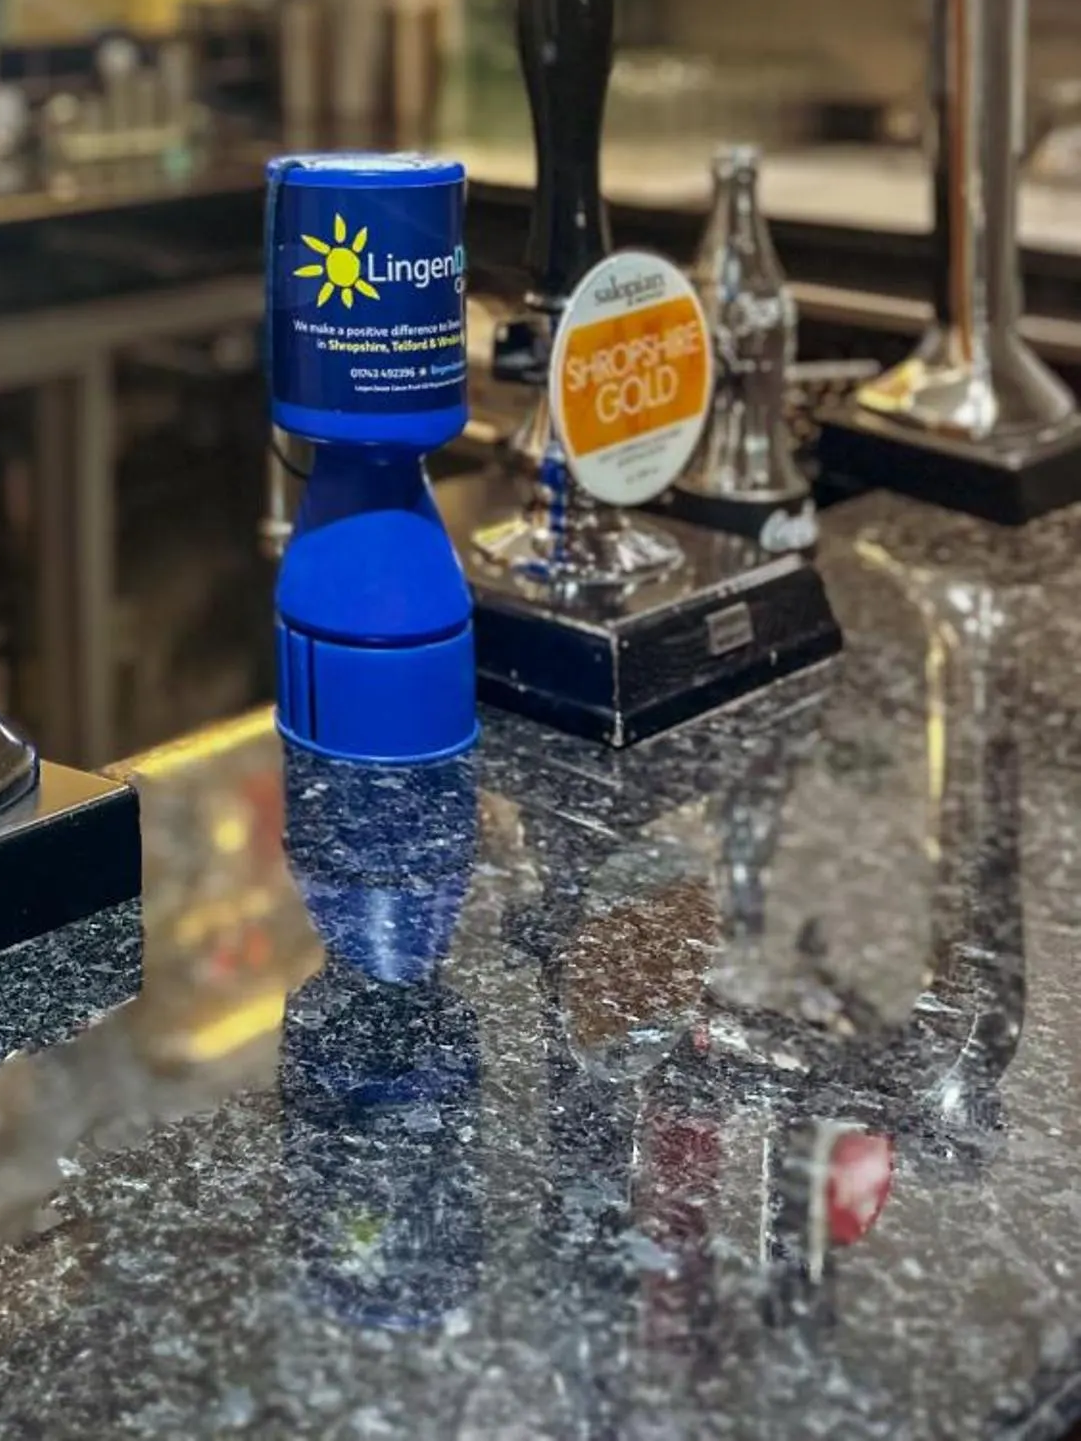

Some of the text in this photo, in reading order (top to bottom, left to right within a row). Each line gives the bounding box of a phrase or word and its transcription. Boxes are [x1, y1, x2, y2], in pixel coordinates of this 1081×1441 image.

[309, 322, 336, 336] make
[347, 326, 389, 338] positive
[391, 323, 438, 337] difference
[328, 340, 390, 354] Shropshire,
[392, 339, 428, 352] Telford
[595, 365, 678, 424] GOLD
